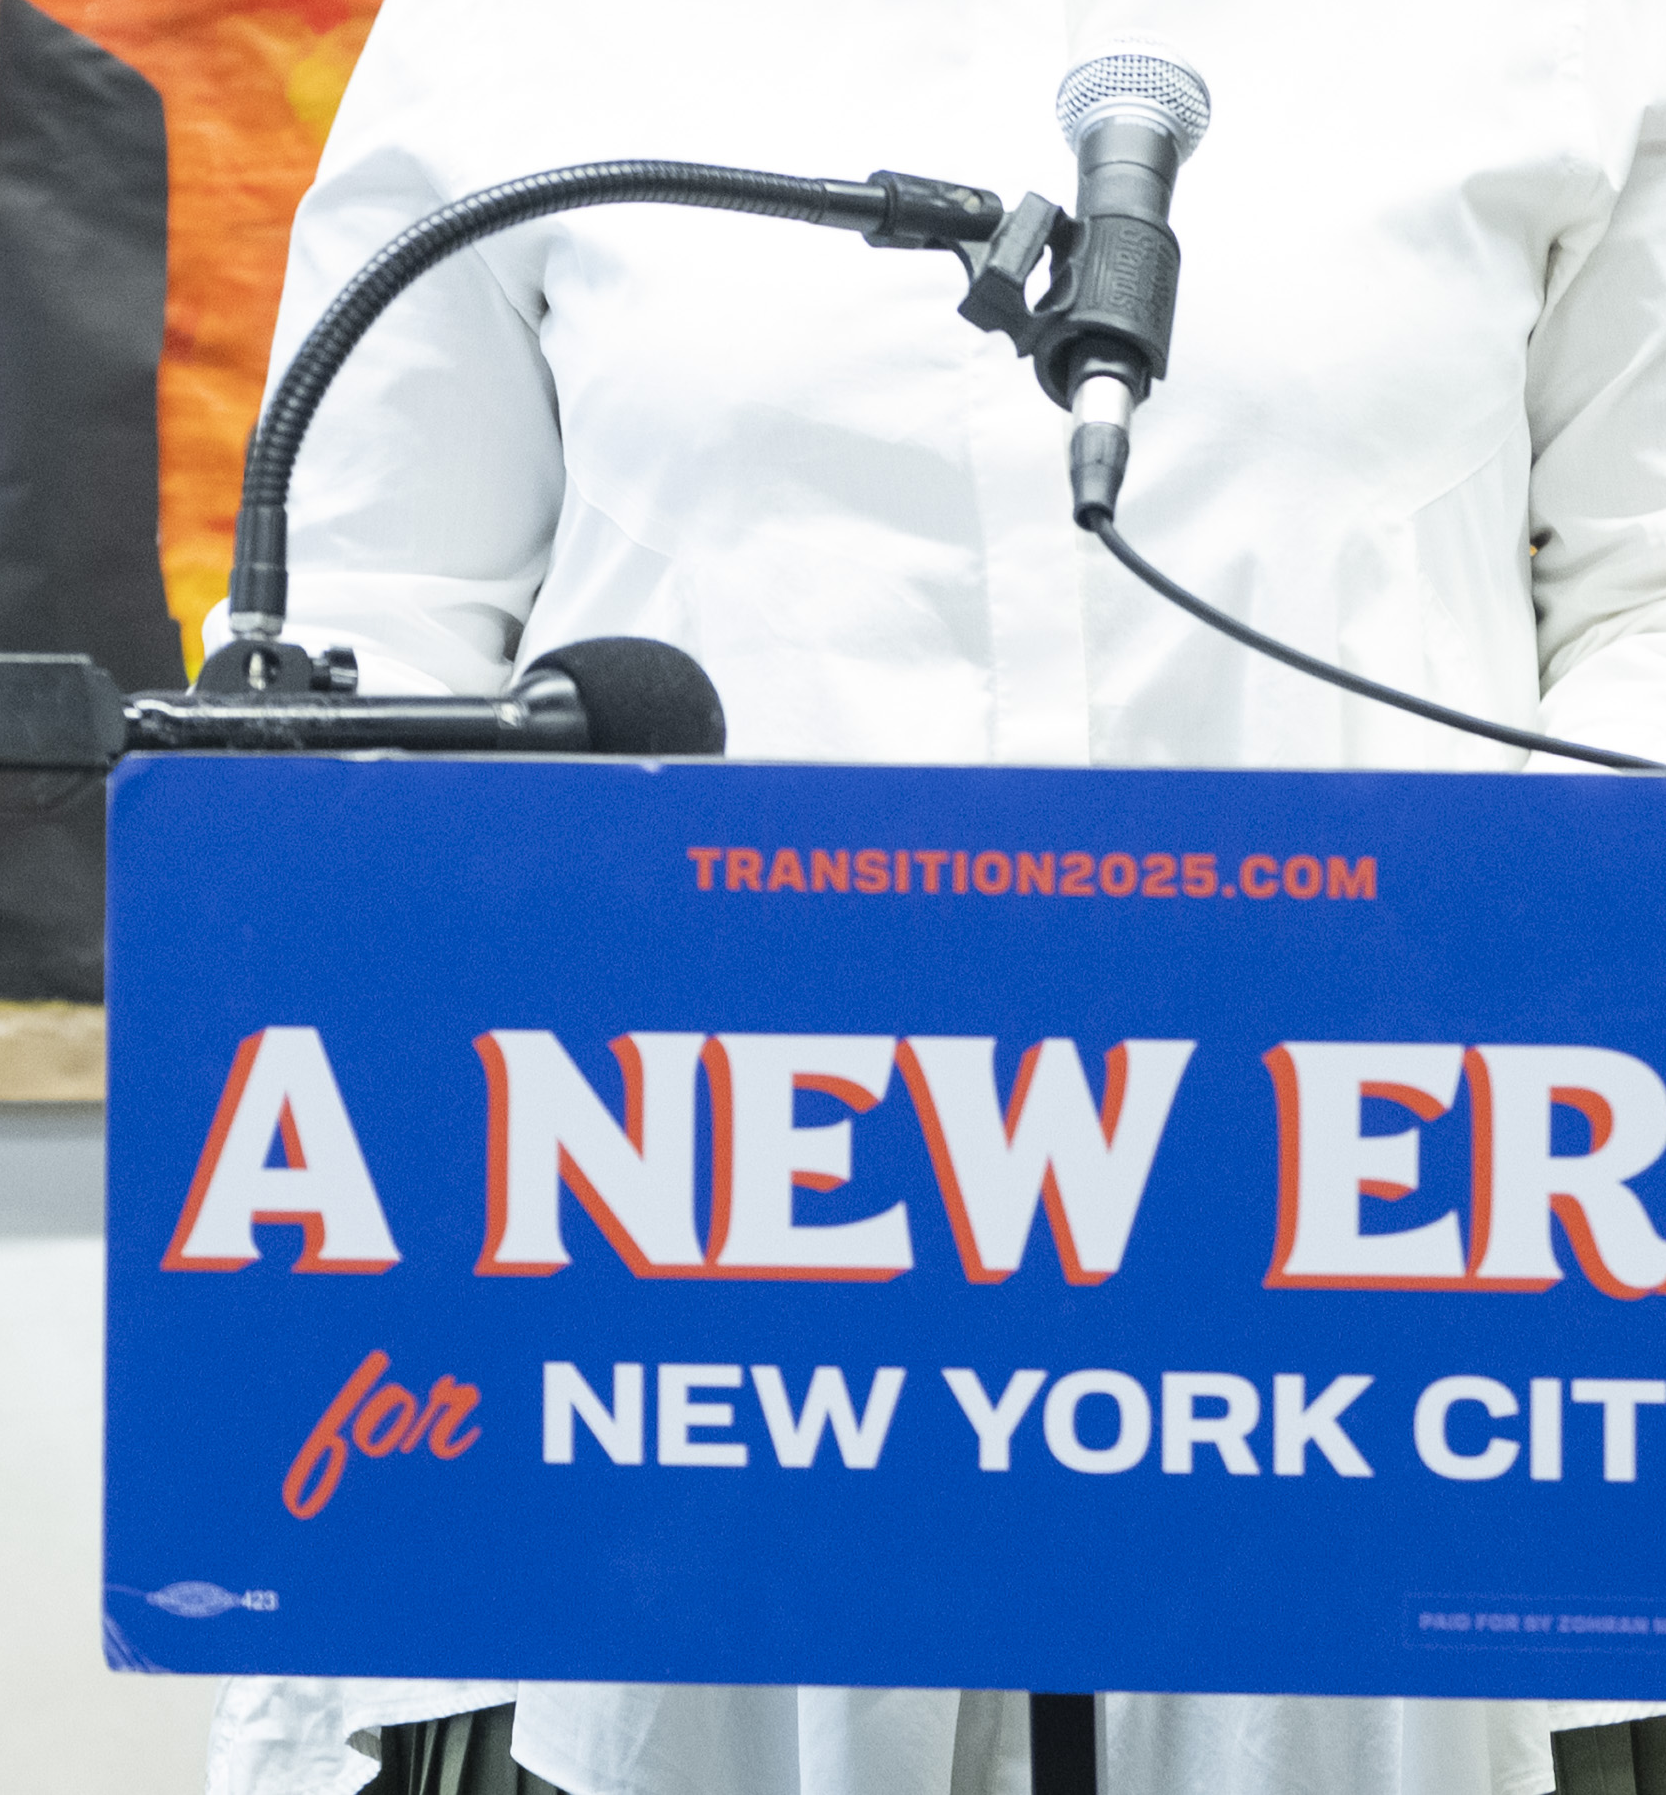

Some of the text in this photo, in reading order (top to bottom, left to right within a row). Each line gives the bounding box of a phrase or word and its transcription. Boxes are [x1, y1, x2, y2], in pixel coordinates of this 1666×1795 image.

[689, 848, 1375, 898] TRANSITION2025.COM
[163, 1026, 401, 1272] A
[476, 1030, 1196, 1284] NEW
[284, 1351, 478, 1518] for
[544, 1362, 905, 1469] NEW
[943, 1369, 1373, 1477] YORK
[1419, 1611, 1471, 1632] PAID
[1475, 1612, 1520, 1633] FOR
[1524, 1613, 1551, 1633] BY
[1558, 1614, 1649, 1636] ZOHRAN
